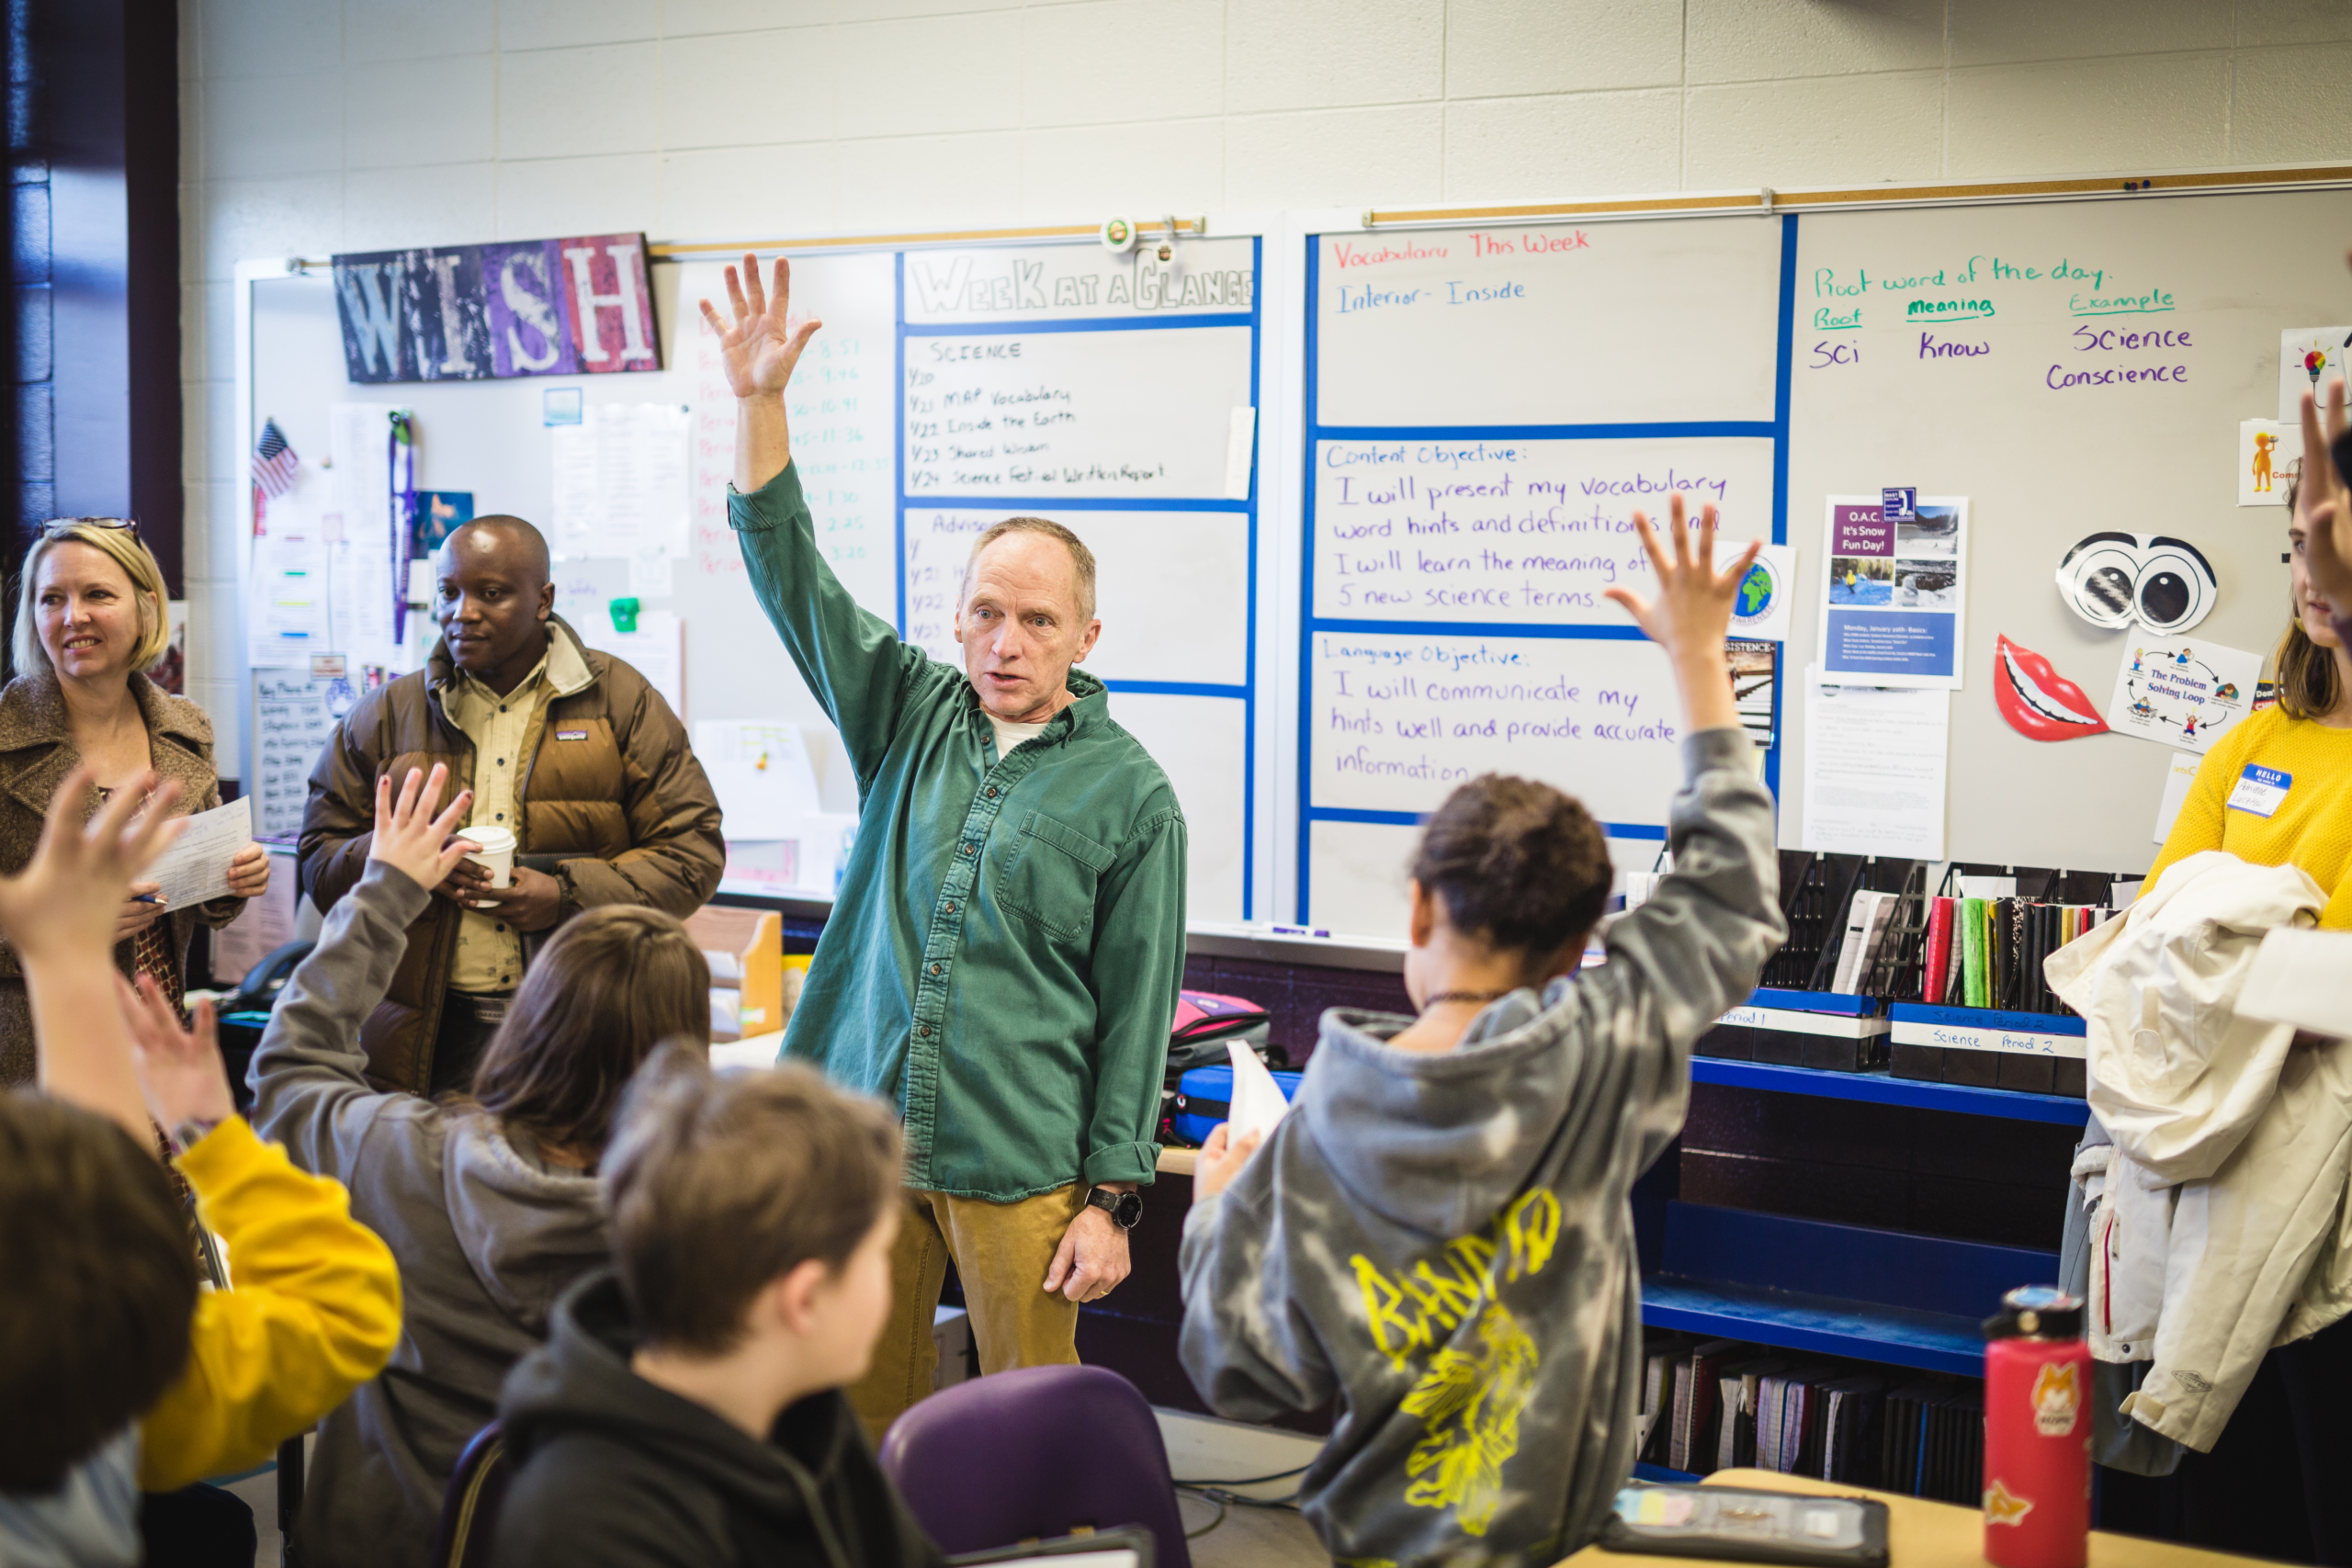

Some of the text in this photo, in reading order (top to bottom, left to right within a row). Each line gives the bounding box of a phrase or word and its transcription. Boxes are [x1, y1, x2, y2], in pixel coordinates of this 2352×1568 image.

[1469, 232, 1515, 258] This
[1523, 230, 1591, 254] Week
[1815, 267, 1872, 299] Root
[1882, 269, 1946, 290] word
[1957, 255, 1986, 285] of
[1992, 257, 2044, 281] the
[1054, 275, 1100, 306] AT
[1107, 275, 1130, 304] A
[1444, 280, 1527, 305] Inside
[334, 243, 654, 375] WISH
[1814, 308, 1863, 328] Root
[2068, 288, 2175, 312] Example
[930, 342, 1022, 362] SCIENCE
[1809, 324, 2193, 368] Sci Know Science
[2046, 364, 2188, 389] Conscience
[944, 388, 982, 409] MAP
[990, 385, 1072, 406] Vocabulary
[910, 411, 1075, 438] 1/22 Inside the Earth
[911, 444, 939, 463] 1/23
[948, 445, 995, 461] Shared
[1326, 445, 1406, 468] Content
[953, 469, 1001, 485] Science
[1063, 464, 1118, 483] Written
[1335, 468, 1727, 511] I will present my vocabulary
[1333, 516, 1393, 540] word
[1407, 515, 1461, 536] hints
[1472, 508, 1512, 535] and
[1670, 508, 1721, 535] nd
[1843, 525, 1886, 536] It's Snow
[1842, 539, 1885, 553] Fun Day!
[1335, 553, 1361, 576] I
[1366, 549, 1402, 574] will
[1418, 551, 1471, 573] learn
[1479, 547, 1516, 571] the
[1521, 556, 1616, 581] meaning
[1338, 584, 1353, 607] 5
[1364, 586, 1413, 605] new
[1424, 585, 1511, 607] science
[1323, 638, 1413, 667] Language
[2152, 669, 2168, 681] The
[2170, 673, 2207, 690] Problem
[1332, 671, 1639, 716] I will communicate my
[2147, 682, 2180, 700] Solving
[2182, 691, 2205, 705] Loop
[1331, 707, 1676, 744] hints well and provide accurate
[2256, 770, 2281, 782] HELLO
[1933, 1010, 2047, 1030] Science Period 2
[1933, 1030, 2054, 1054] Science Period 2
